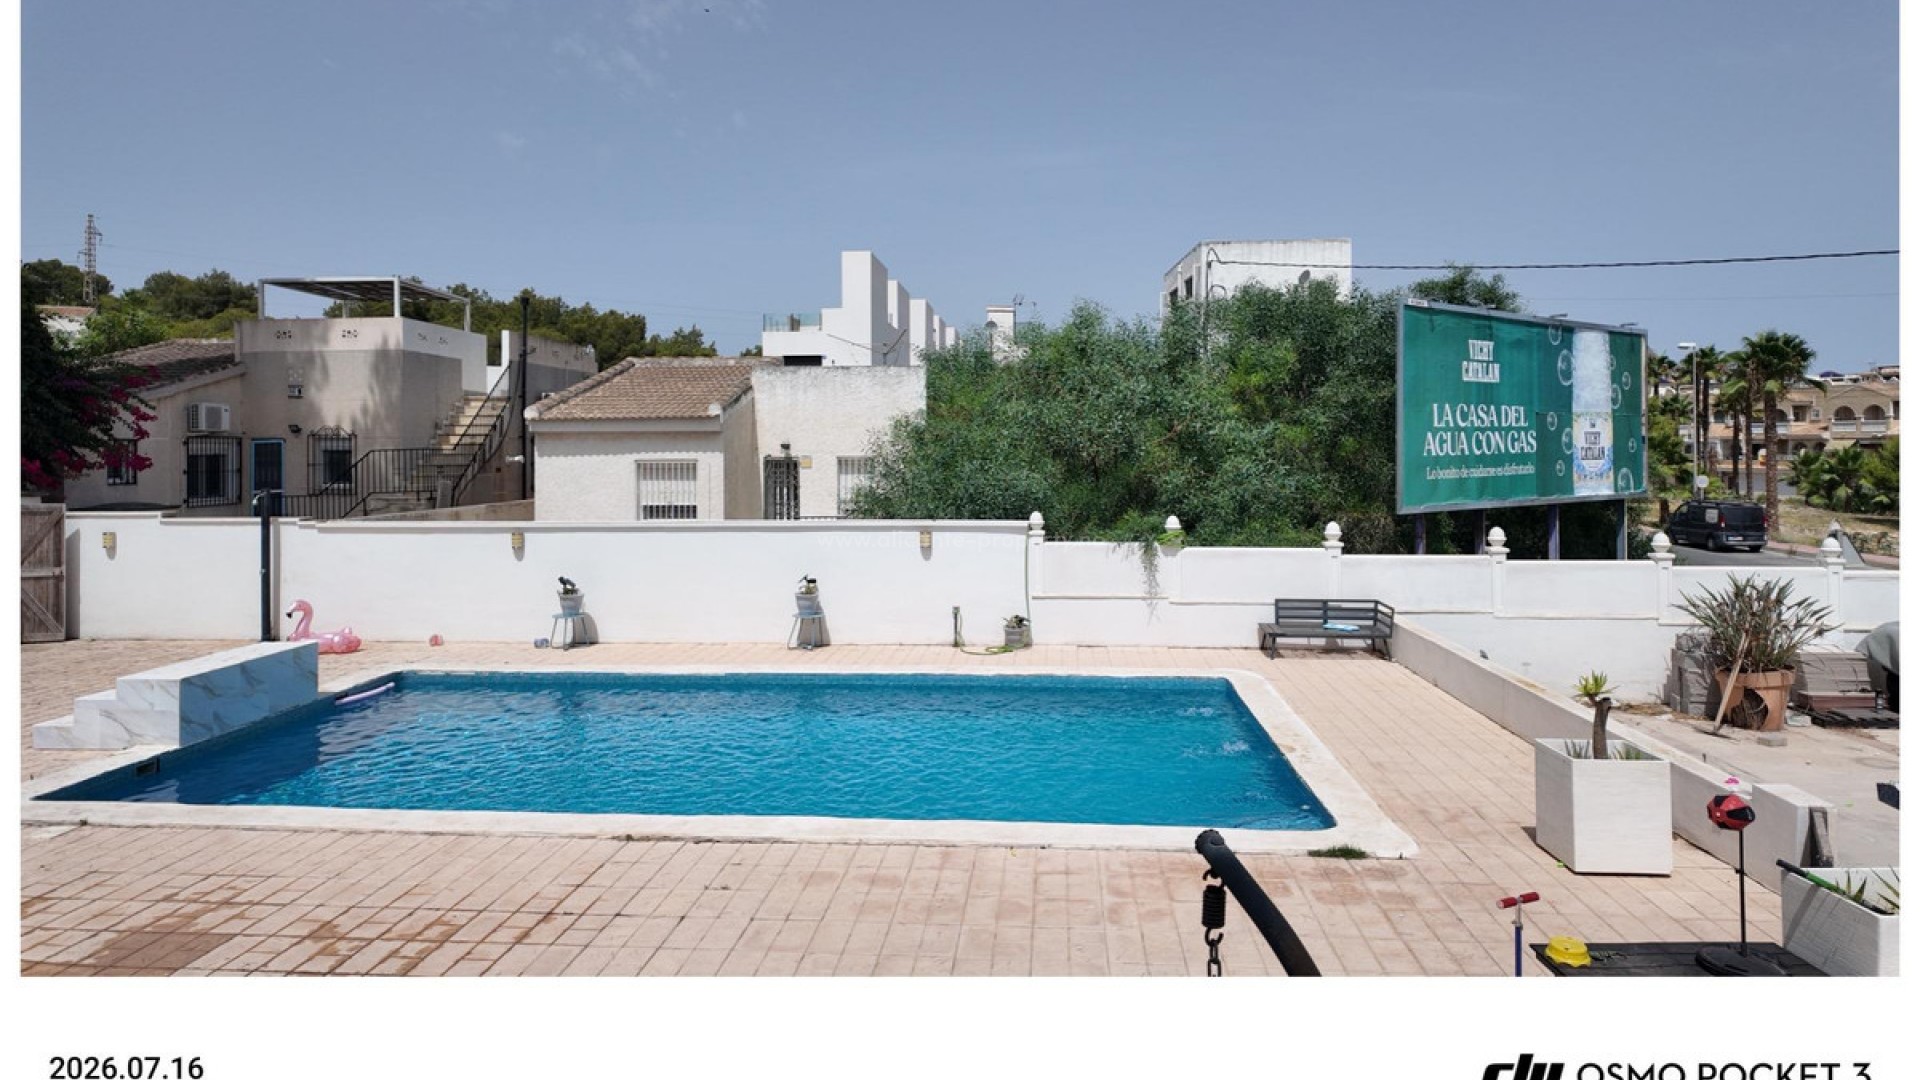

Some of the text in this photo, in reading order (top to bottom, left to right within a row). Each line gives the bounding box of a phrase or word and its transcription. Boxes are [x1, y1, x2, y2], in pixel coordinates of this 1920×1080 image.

[1468, 339, 1495, 361] VICHY
[1462, 361, 1500, 383] CATALAN
[1433, 403, 1529, 428] LA CASA DEL
[1423, 429, 1537, 456] AGUA CON GAS
